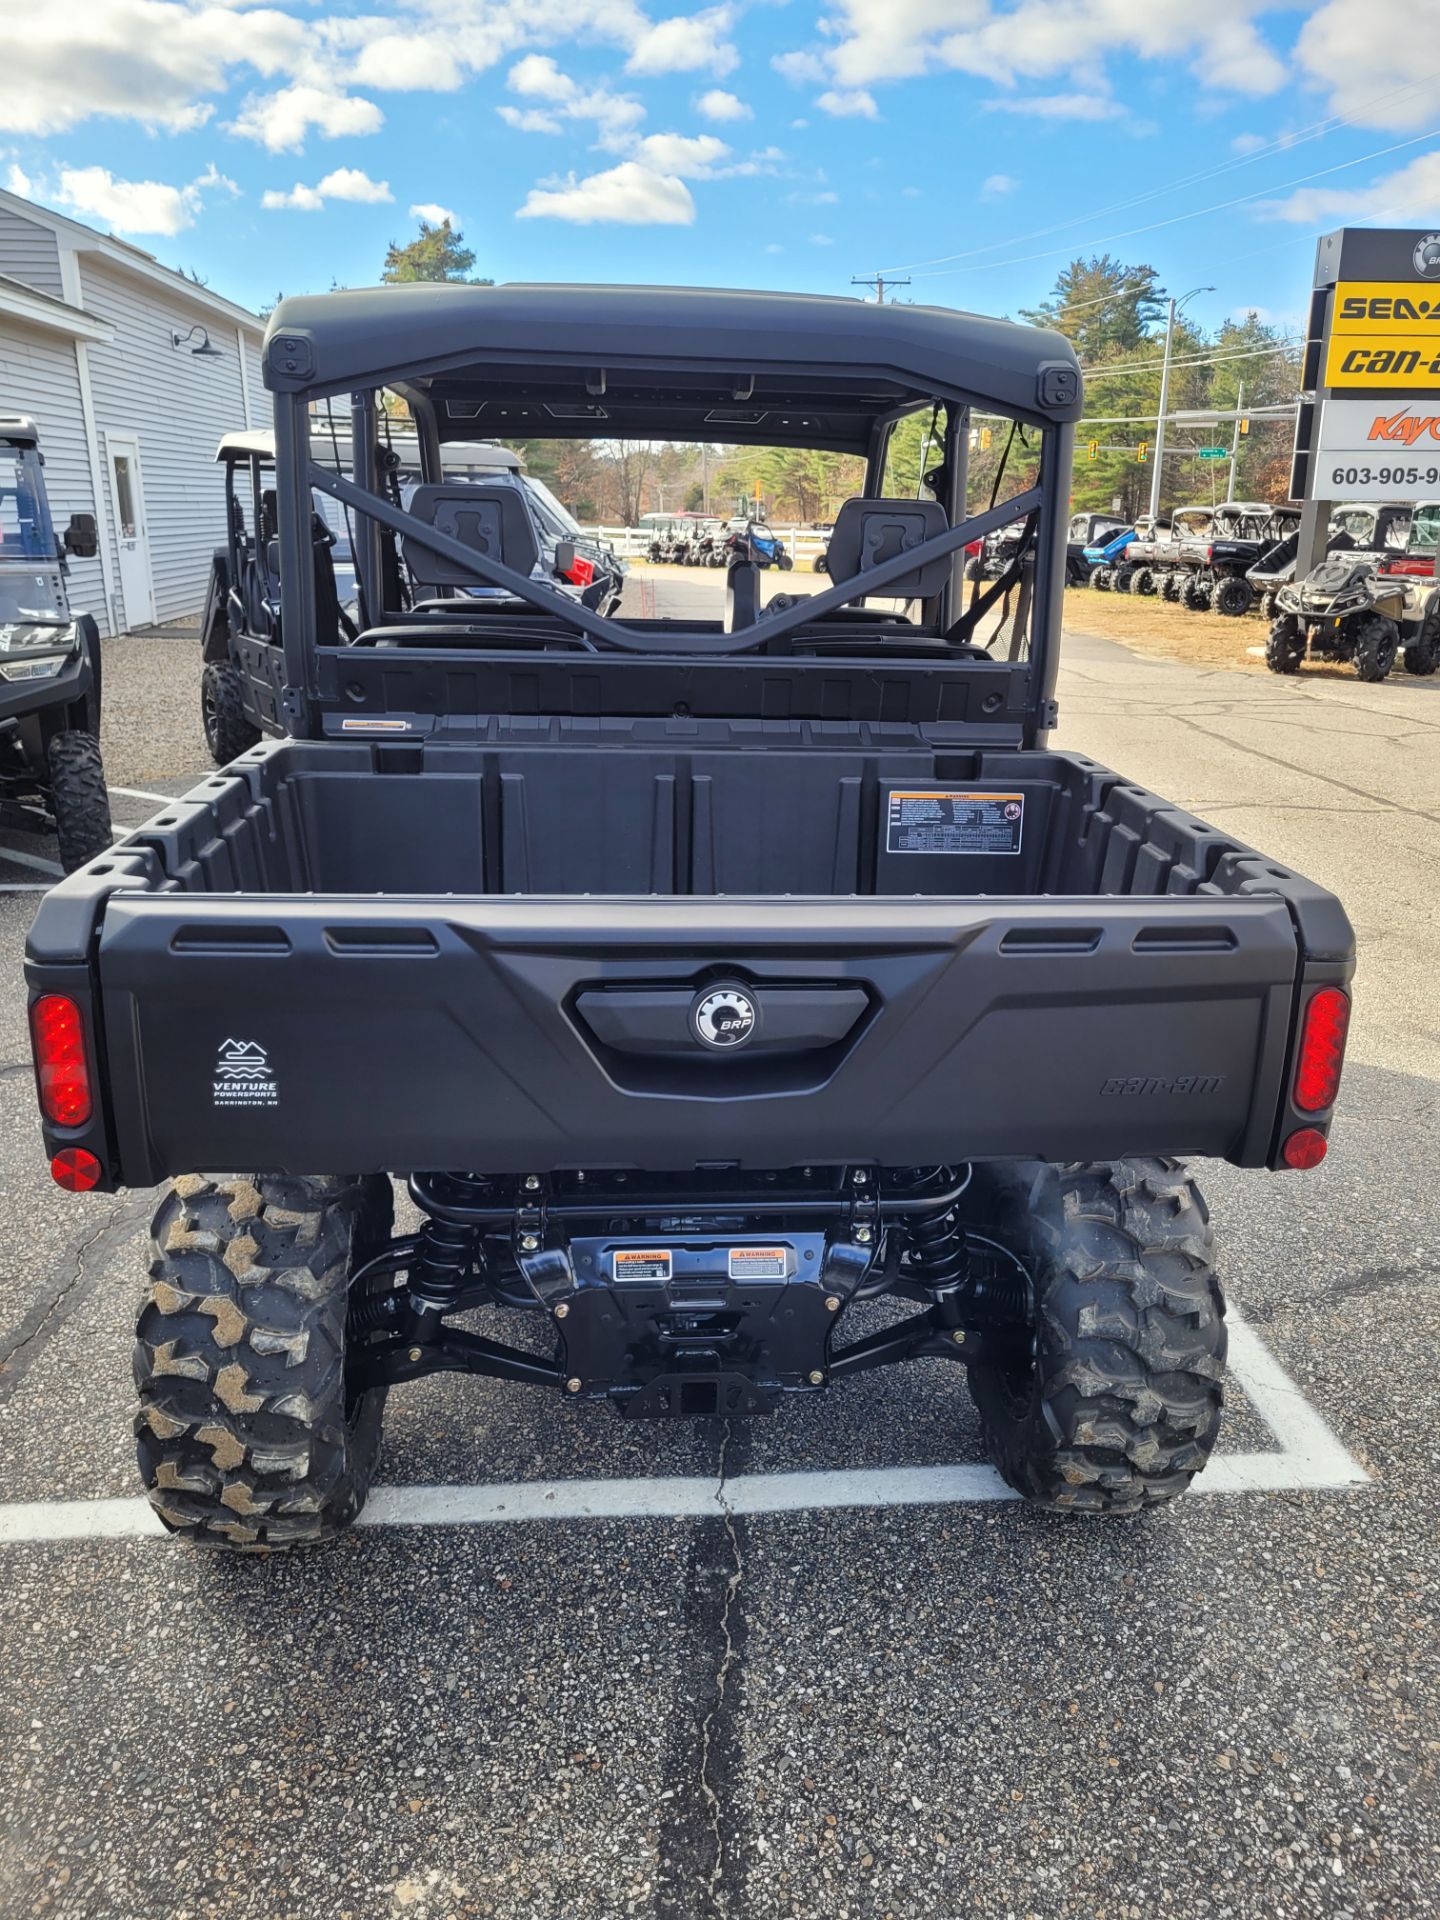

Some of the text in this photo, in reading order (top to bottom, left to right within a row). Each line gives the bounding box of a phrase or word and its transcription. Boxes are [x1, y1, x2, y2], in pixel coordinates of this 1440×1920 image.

[1332, 467, 1440, 485] 603-905-9
[720, 1019, 752, 1030] BRP
[213, 1082, 277, 1091] VENTURE
